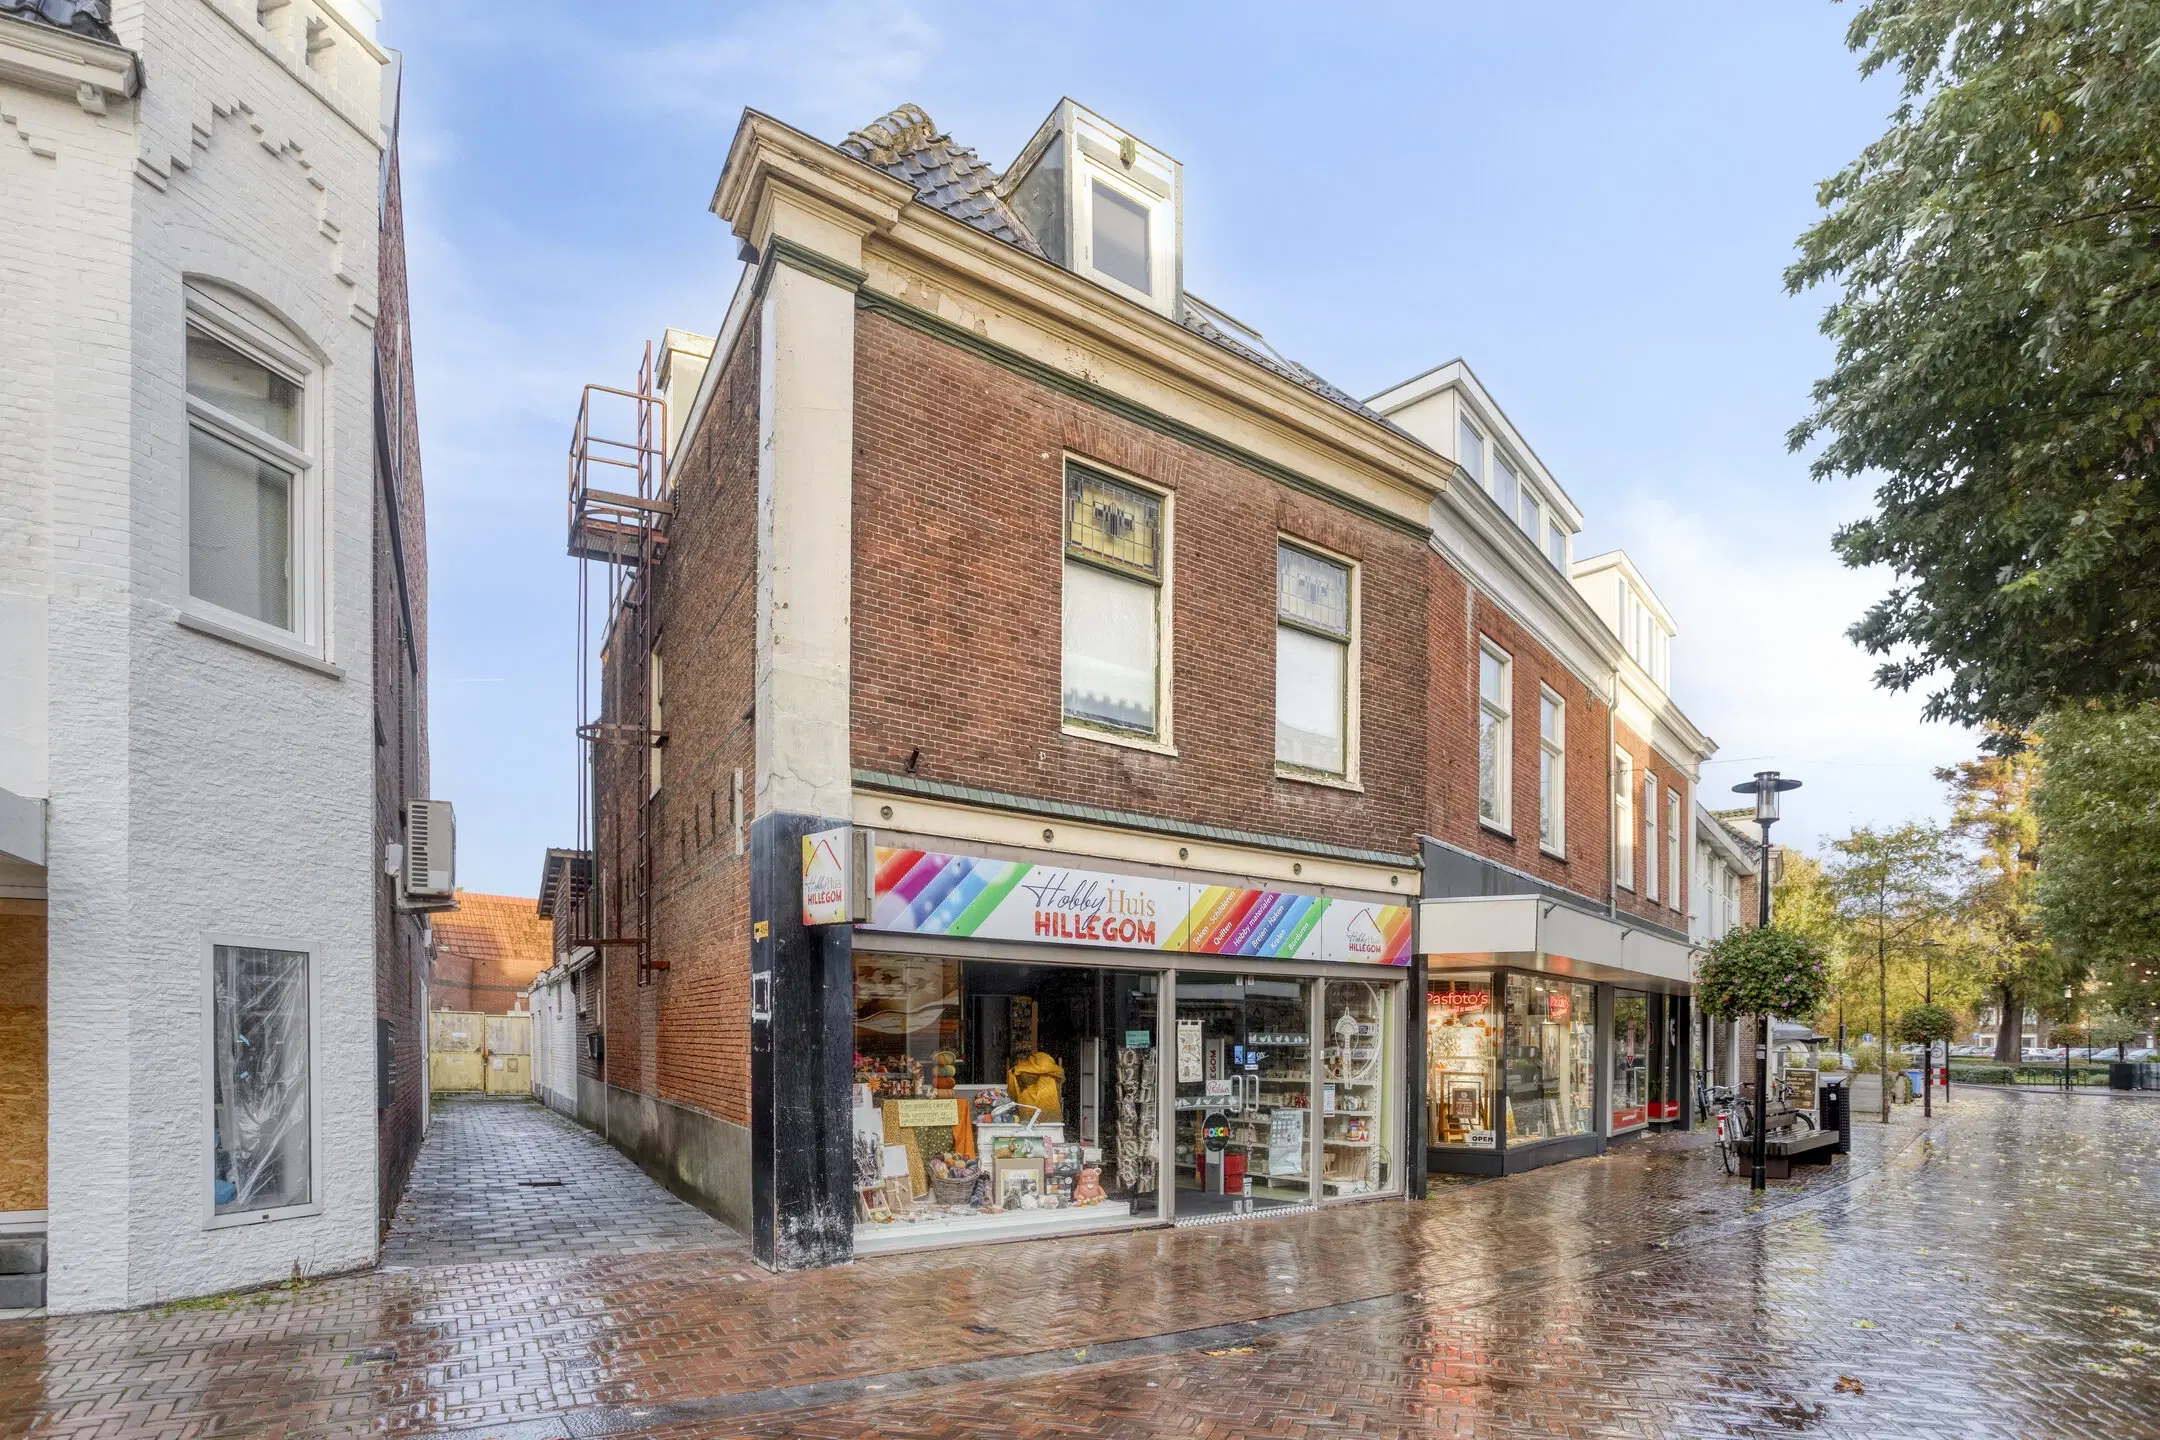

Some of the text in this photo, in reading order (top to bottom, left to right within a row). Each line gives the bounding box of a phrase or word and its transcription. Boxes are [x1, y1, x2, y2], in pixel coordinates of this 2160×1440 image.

[807, 890, 842, 905] HILLEGOM
[1021, 872, 1156, 930] Hobby Huis
[1034, 910, 1156, 945] HILLEGOM
[1193, 925, 1210, 945] Teken
[1210, 891, 1236, 923] Schilderen
[1233, 893, 1274, 947] Hobby materialen
[1251, 928, 1268, 949] Breien
[1268, 905, 1285, 926] Haken
[1213, 922, 1233, 945] Quilten
[1270, 929, 1287, 950] Kralen
[1288, 922, 1310, 951] Borduren
[1349, 943, 1381, 953] HILLEGOM
[1427, 991, 1489, 1006] Pasfoto's
[1203, 1127, 1229, 1138] POSCA
